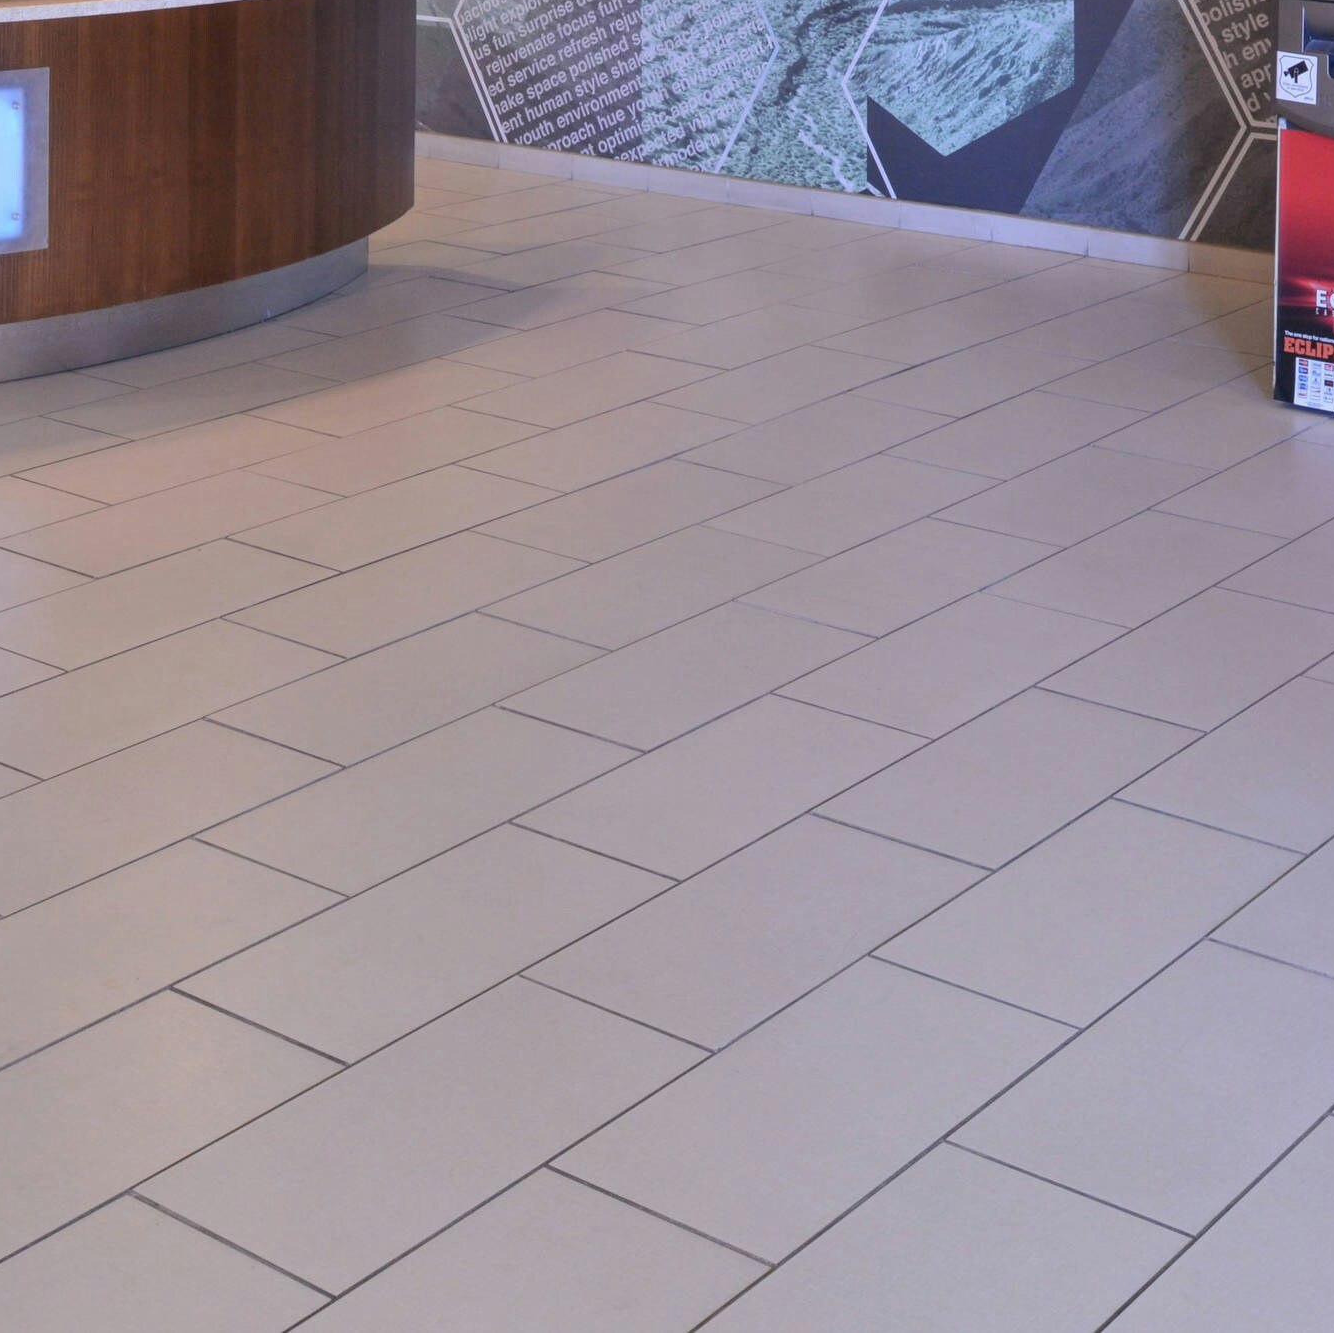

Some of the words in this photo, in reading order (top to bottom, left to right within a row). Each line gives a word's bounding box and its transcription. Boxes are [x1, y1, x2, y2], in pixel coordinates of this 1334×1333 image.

[484, 30, 556, 76] rejuvenate
[557, 10, 597, 40] focus
[492, 30, 516, 50] fun
[519, 0, 574, 38] surprise
[1221, 13, 1269, 43] style
[507, 53, 556, 87] service
[557, 25, 608, 62] refresh
[526, 70, 567, 100] space
[568, 35, 629, 81] polished
[525, 90, 573, 122] human
[575, 67, 609, 98] style
[557, 74, 646, 129] environment
[597, 108, 626, 131] hue
[598, 110, 667, 155] optimistic
